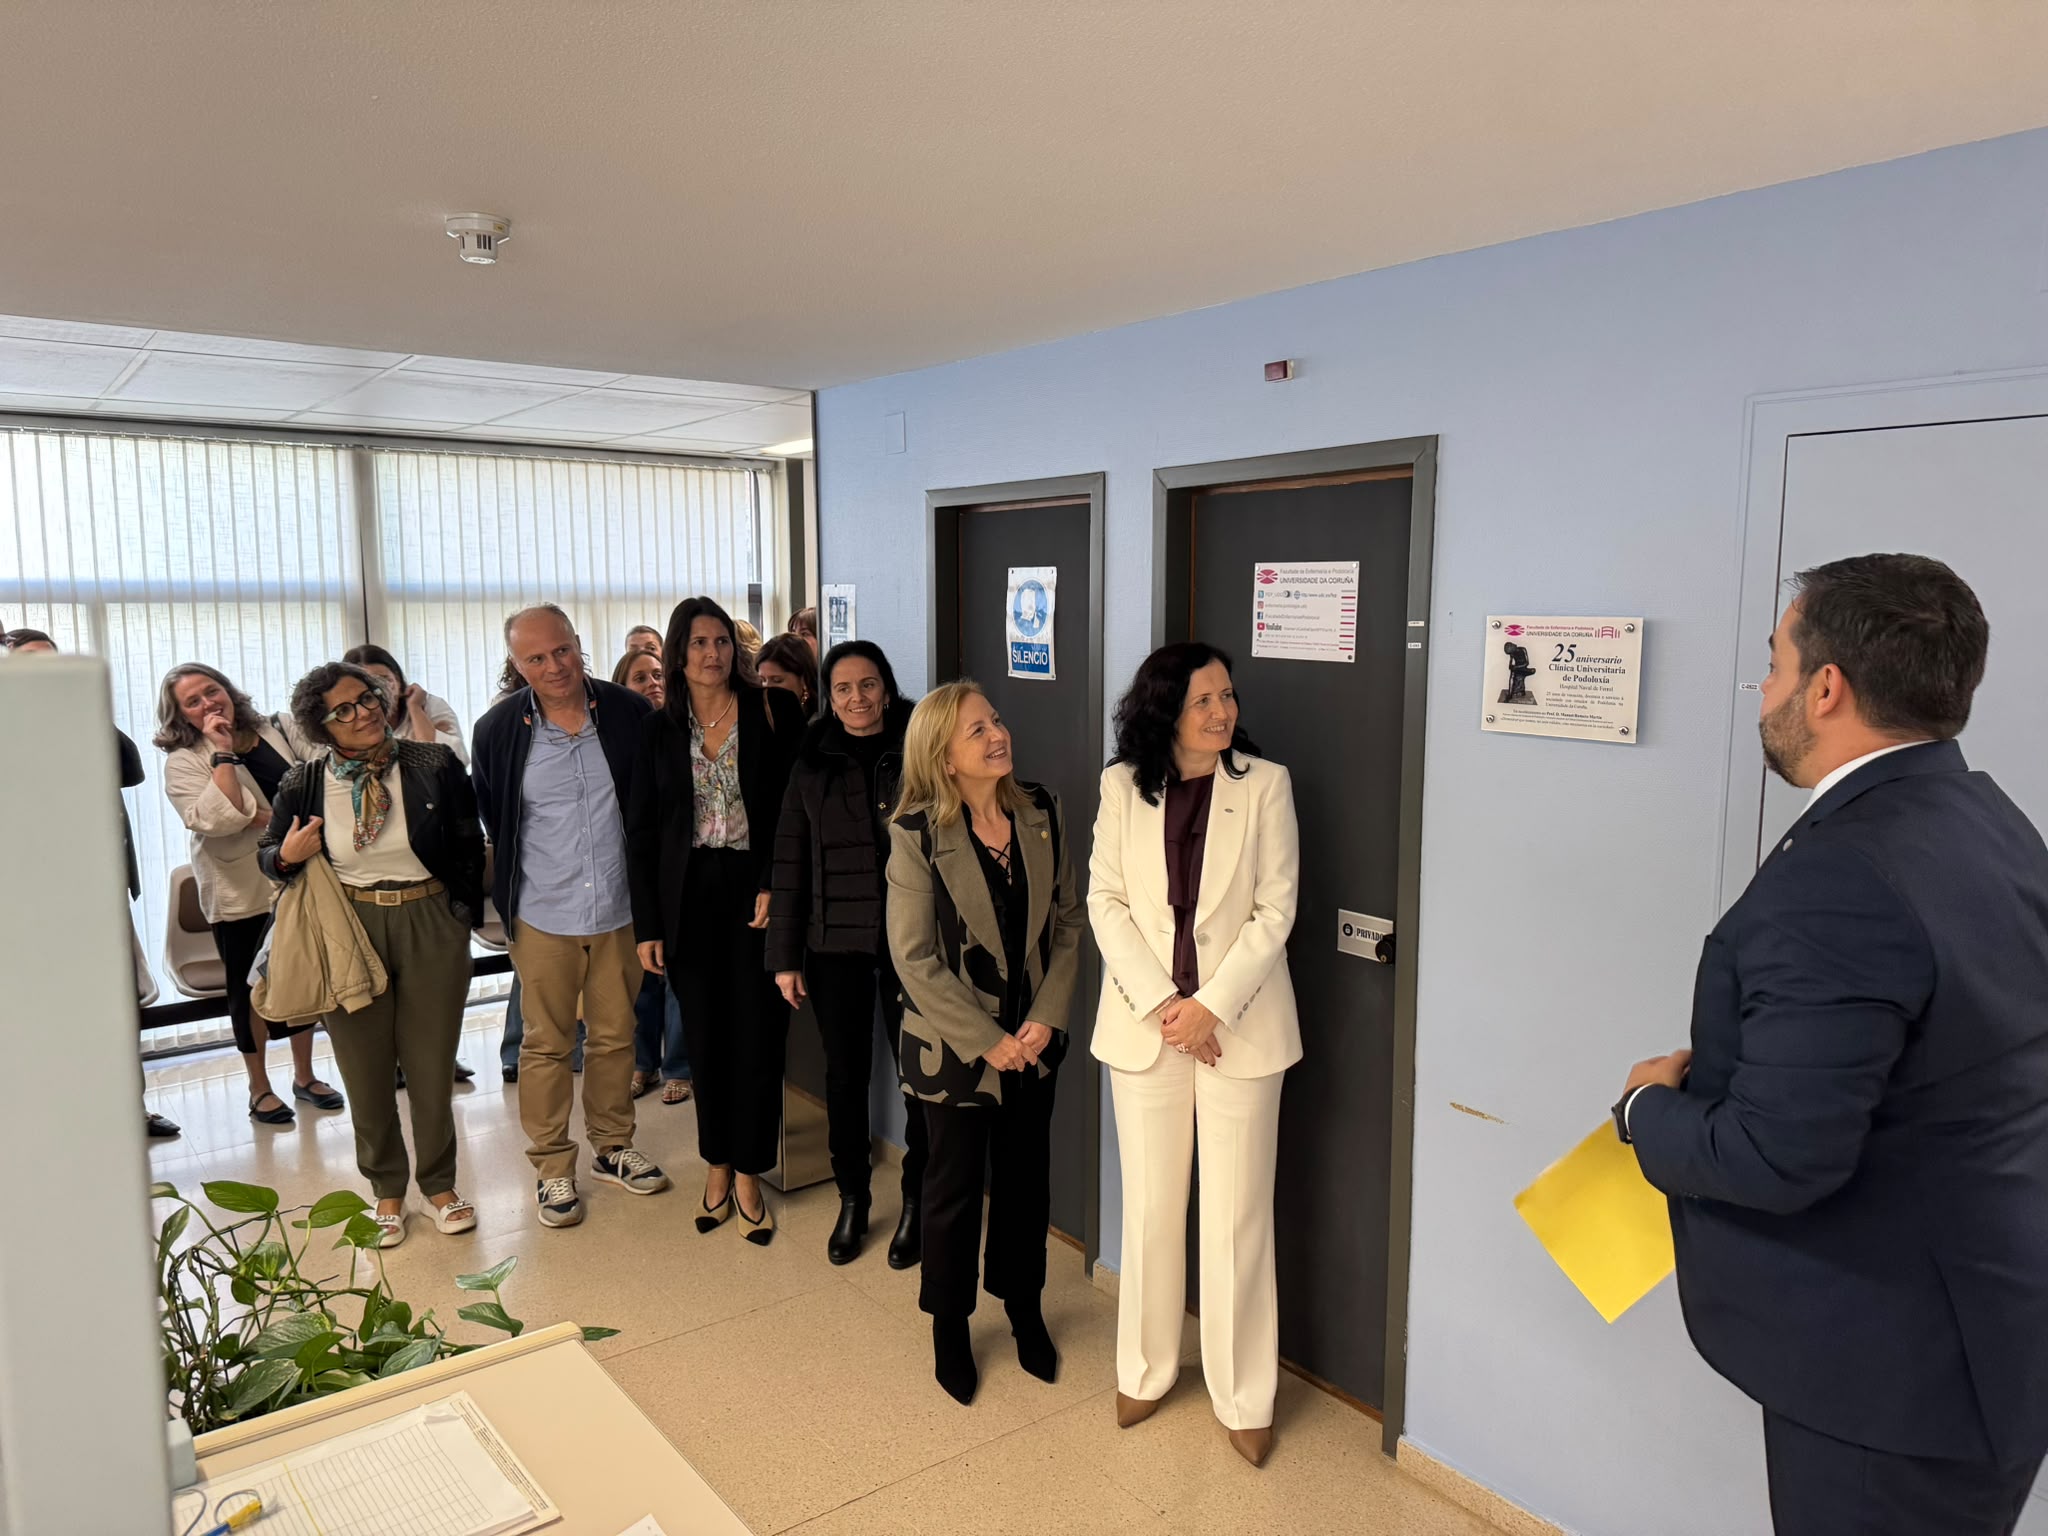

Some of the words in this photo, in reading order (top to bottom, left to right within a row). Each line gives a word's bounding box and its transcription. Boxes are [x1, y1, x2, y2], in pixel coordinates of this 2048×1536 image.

[1328, 576, 1354, 584] CORUÑA
[1266, 623, 1282, 631] YouTube
[1012, 648, 1048, 666] SILENCIO
[1551, 643, 1577, 663] 25
[1576, 655, 1623, 665] aniversario
[1548, 663, 1575, 672] Clínica
[1576, 665, 1626, 675] Universitaria
[1562, 674, 1572, 682] de
[1573, 674, 1610, 684] Podoloxía
